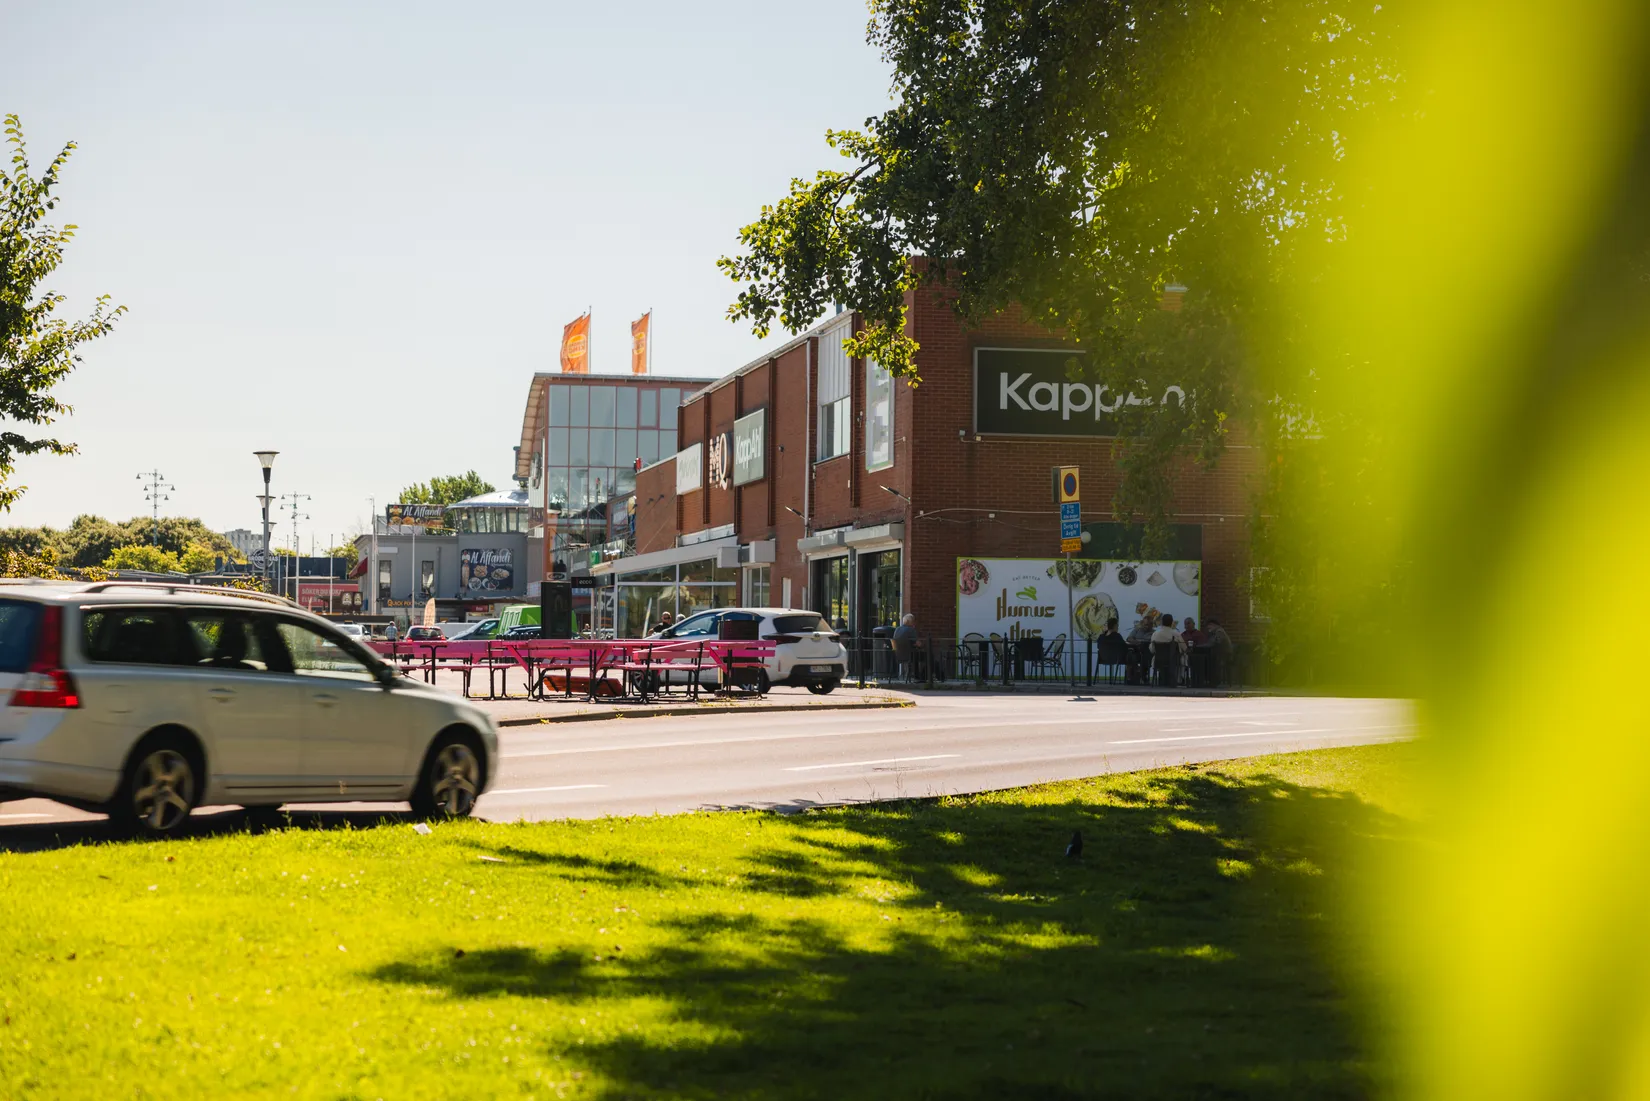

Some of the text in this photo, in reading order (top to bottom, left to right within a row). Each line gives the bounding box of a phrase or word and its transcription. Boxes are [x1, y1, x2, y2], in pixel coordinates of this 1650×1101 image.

[709, 432, 728, 491] MQ
[736, 426, 762, 469] KappAhl
[414, 505, 443, 517] Affandi
[480, 550, 511, 566] Affandi
